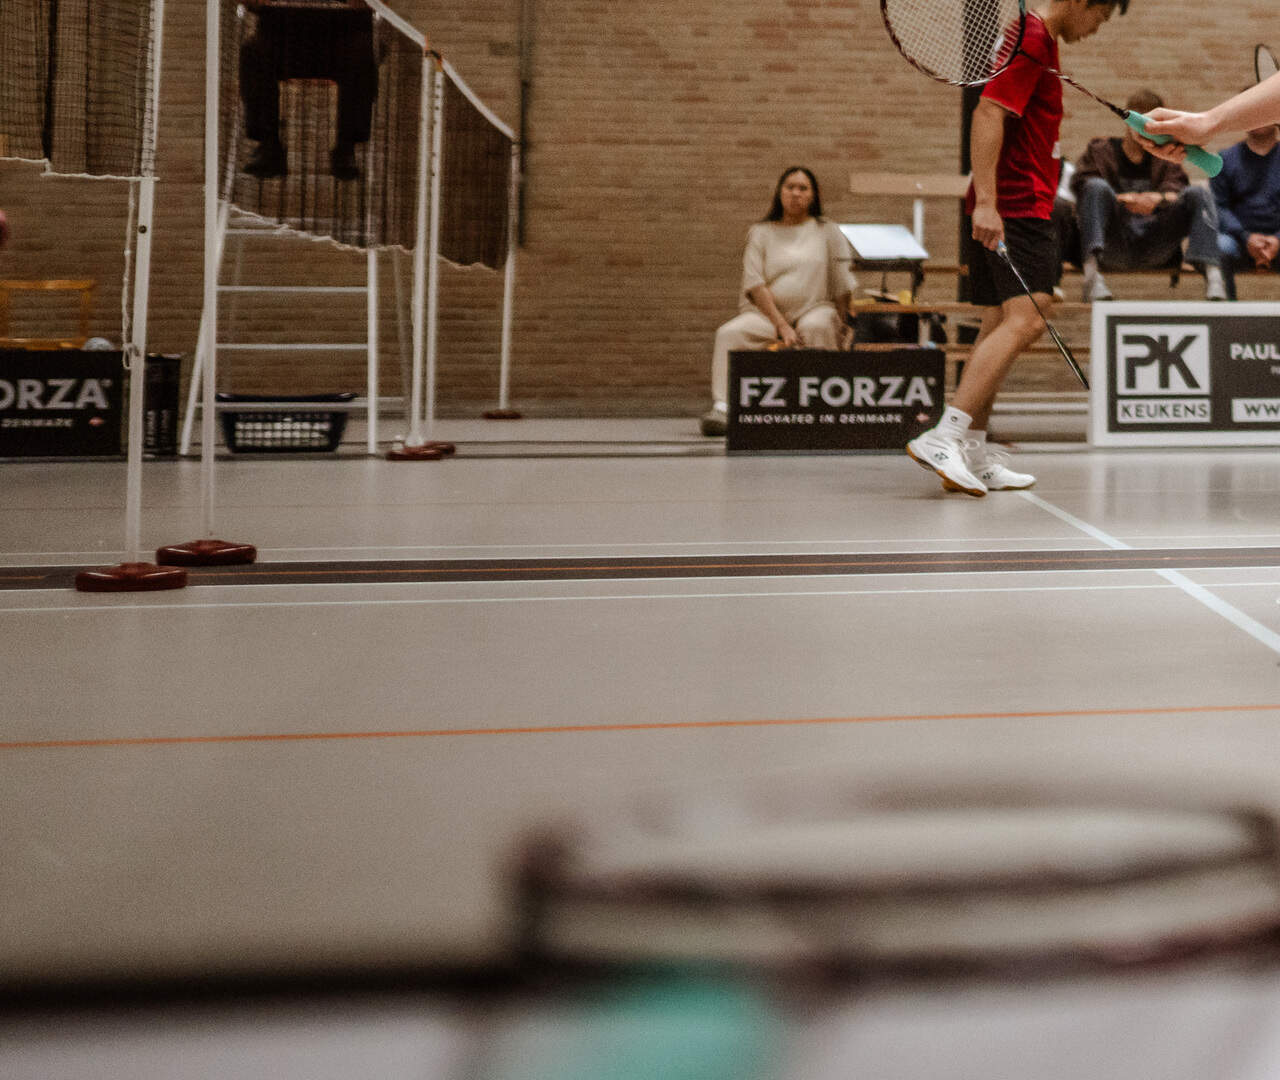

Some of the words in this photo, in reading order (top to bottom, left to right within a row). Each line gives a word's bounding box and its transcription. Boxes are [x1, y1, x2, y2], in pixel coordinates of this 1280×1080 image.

[1229, 343, 1280, 361] PAUL
[1122, 334, 1201, 390] PK
[739, 376, 787, 407] FZ
[738, 413, 815, 425] INNOVATED
[819, 413, 835, 424] IN
[839, 413, 902, 424] DENMARK
[1120, 402, 1209, 419] KEUKENS
